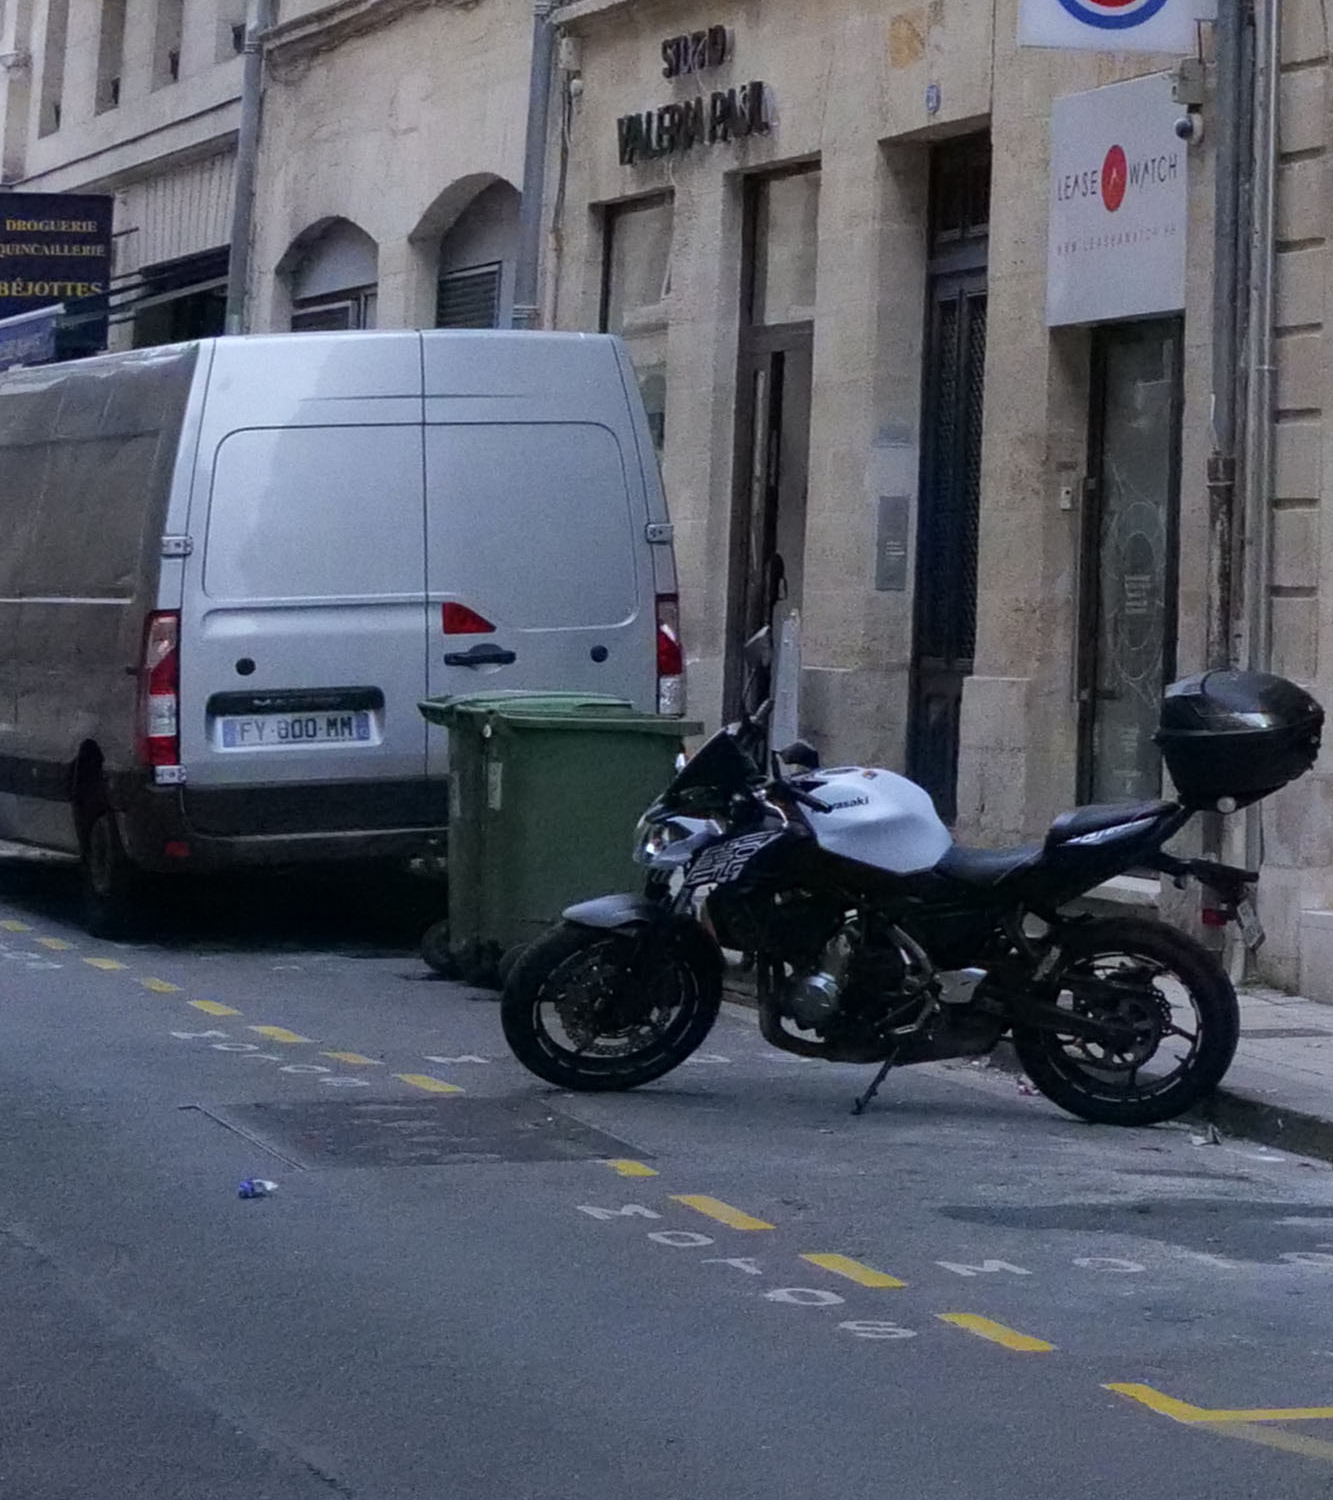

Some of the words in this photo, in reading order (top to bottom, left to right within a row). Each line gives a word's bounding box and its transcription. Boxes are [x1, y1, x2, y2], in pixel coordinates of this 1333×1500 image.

[617, 96, 704, 166] VALERIA
[710, 80, 770, 144] PAUL
[1057, 169, 1099, 202] LEASE
[1129, 153, 1178, 193] WATCH
[5, 219, 97, 233] DROGUERIE
[576, 1202, 918, 1339] MOTOS
